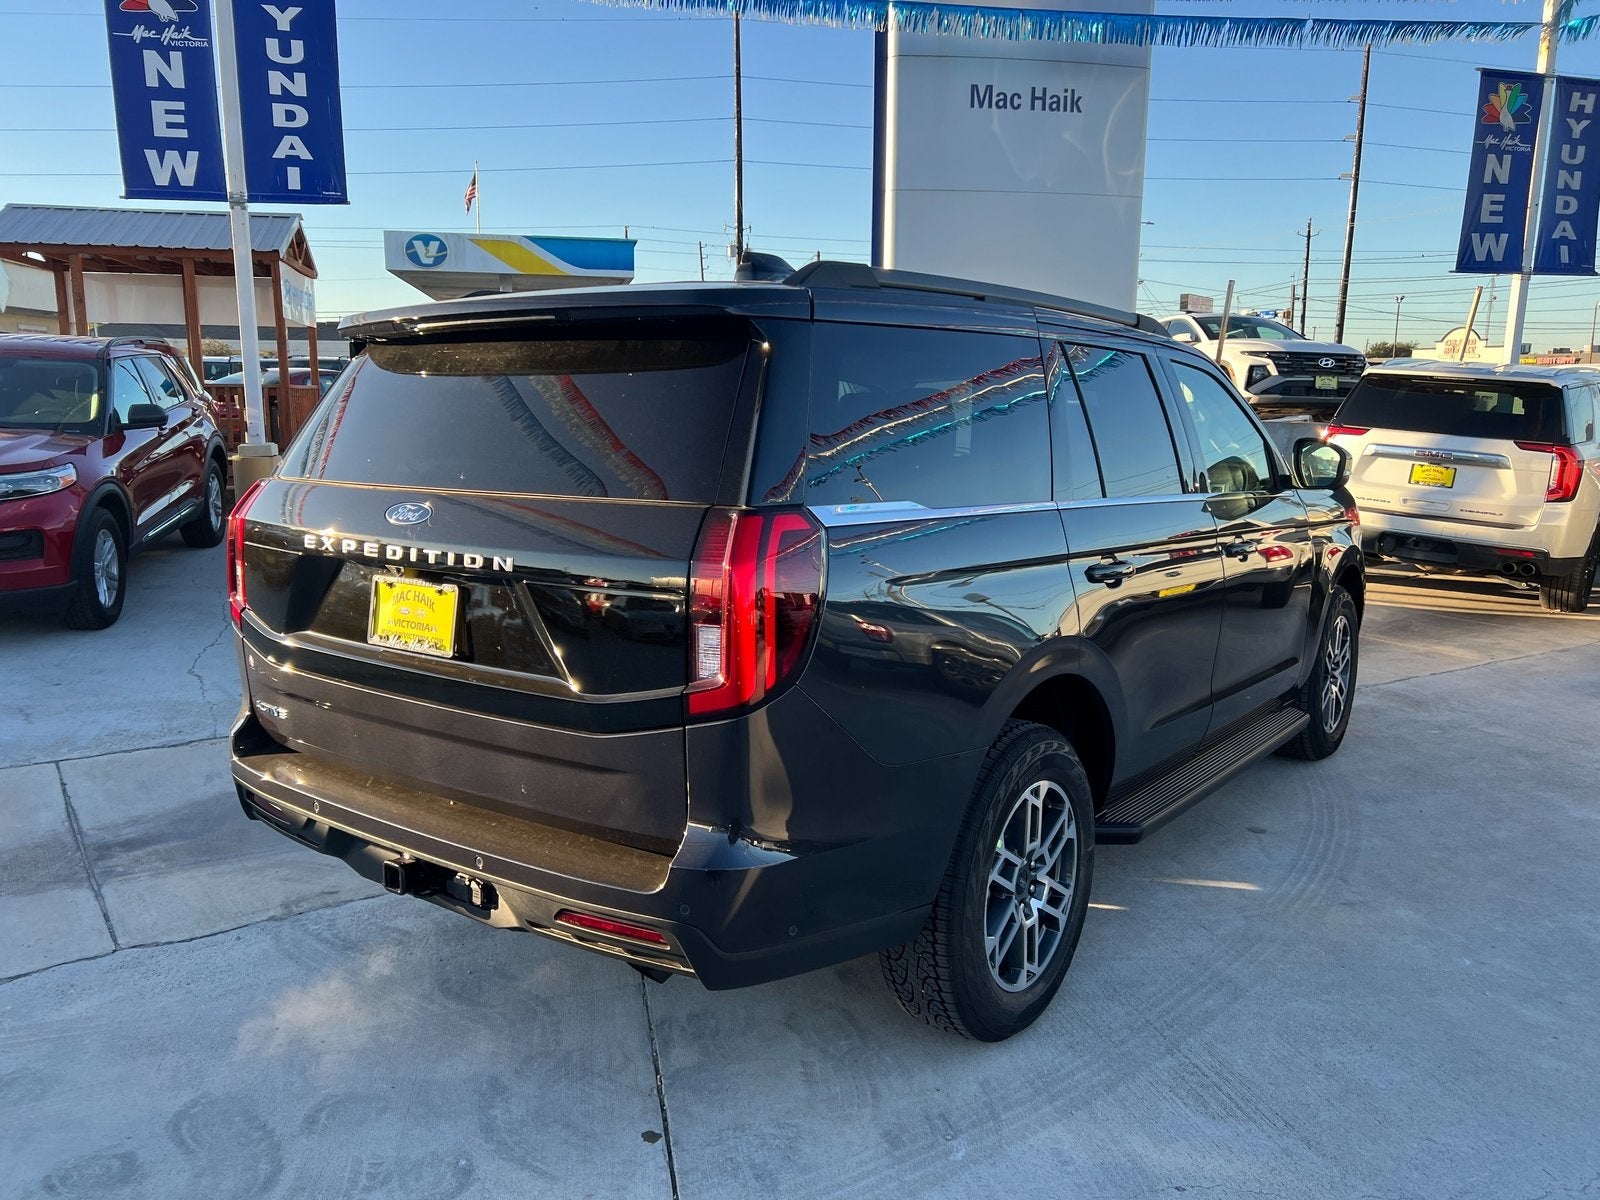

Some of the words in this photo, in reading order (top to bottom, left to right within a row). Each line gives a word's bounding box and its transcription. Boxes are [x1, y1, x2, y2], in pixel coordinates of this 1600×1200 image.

[122, 24, 161, 44] Mac
[161, 24, 200, 46] Haik
[970, 84, 1022, 110] Mac
[1030, 86, 1083, 113] Haik
[143, 49, 199, 187] NEW
[1551, 92, 1597, 264] HYUNDAI
[1471, 153, 1512, 262] NEW
[1414, 450, 1453, 459] GMC
[1355, 496, 1391, 504] YUKON
[391, 504, 425, 523] Ford
[1459, 508, 1504, 517] DENALI
[304, 534, 514, 572] EXPEDITION
[392, 589, 412, 607] MAC
[413, 590, 435, 613] HAIK
[394, 619, 433, 633] VICTORIA
